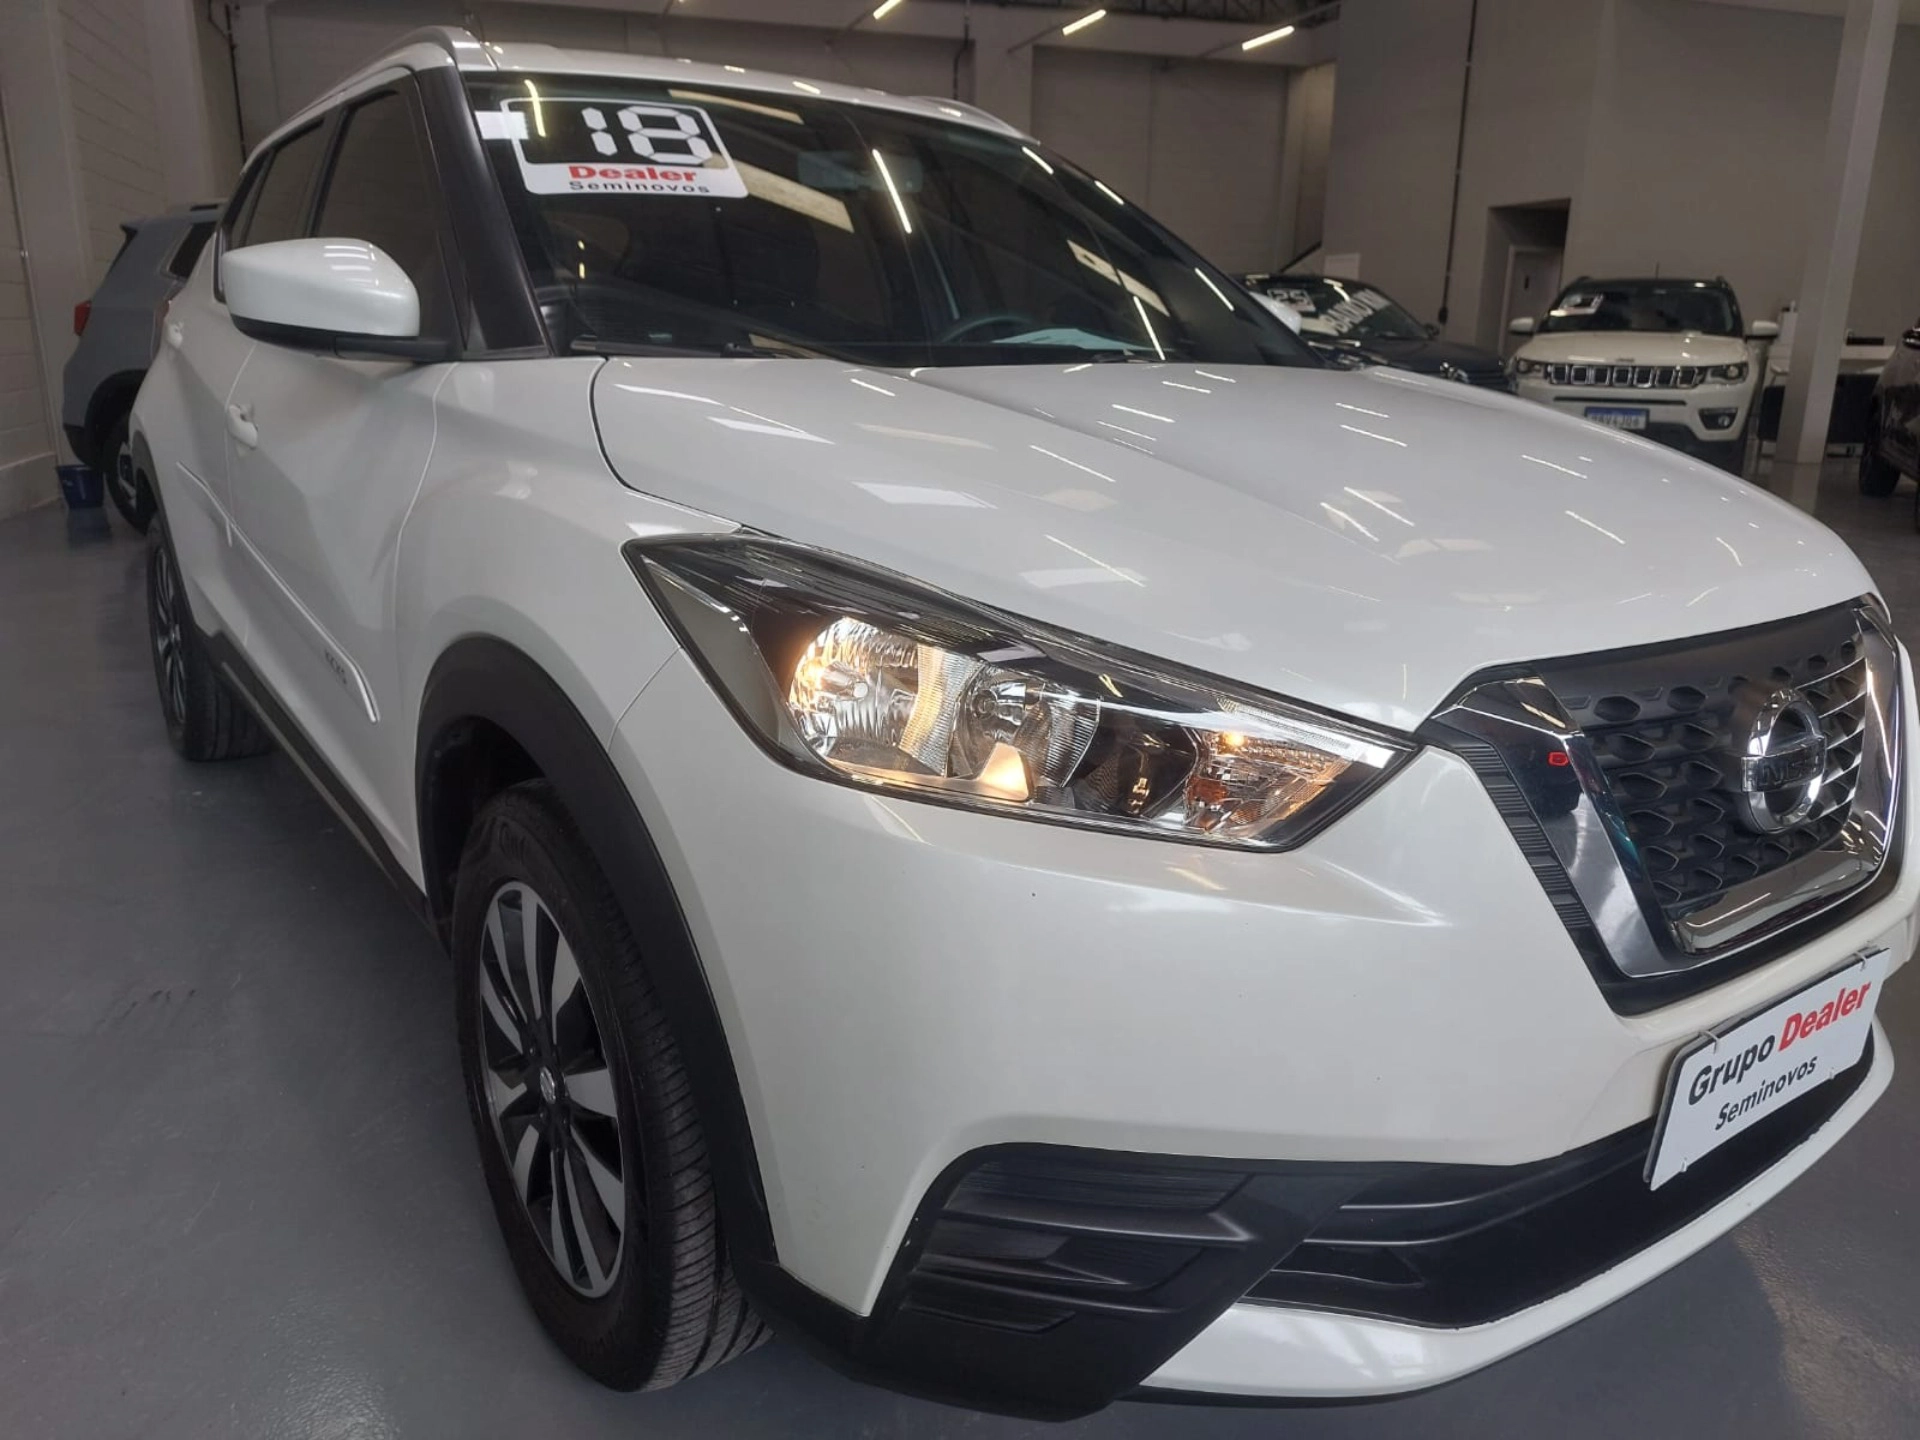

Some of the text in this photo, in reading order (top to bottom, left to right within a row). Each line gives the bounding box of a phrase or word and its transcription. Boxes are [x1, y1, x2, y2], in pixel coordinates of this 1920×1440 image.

[581, 106, 713, 165] 18
[568, 165, 698, 182] Dealer
[570, 181, 710, 194] Seminovos
[1688, 982, 1872, 1106] Grupo Dealer
[1715, 1056, 1818, 1131] Seminovos
